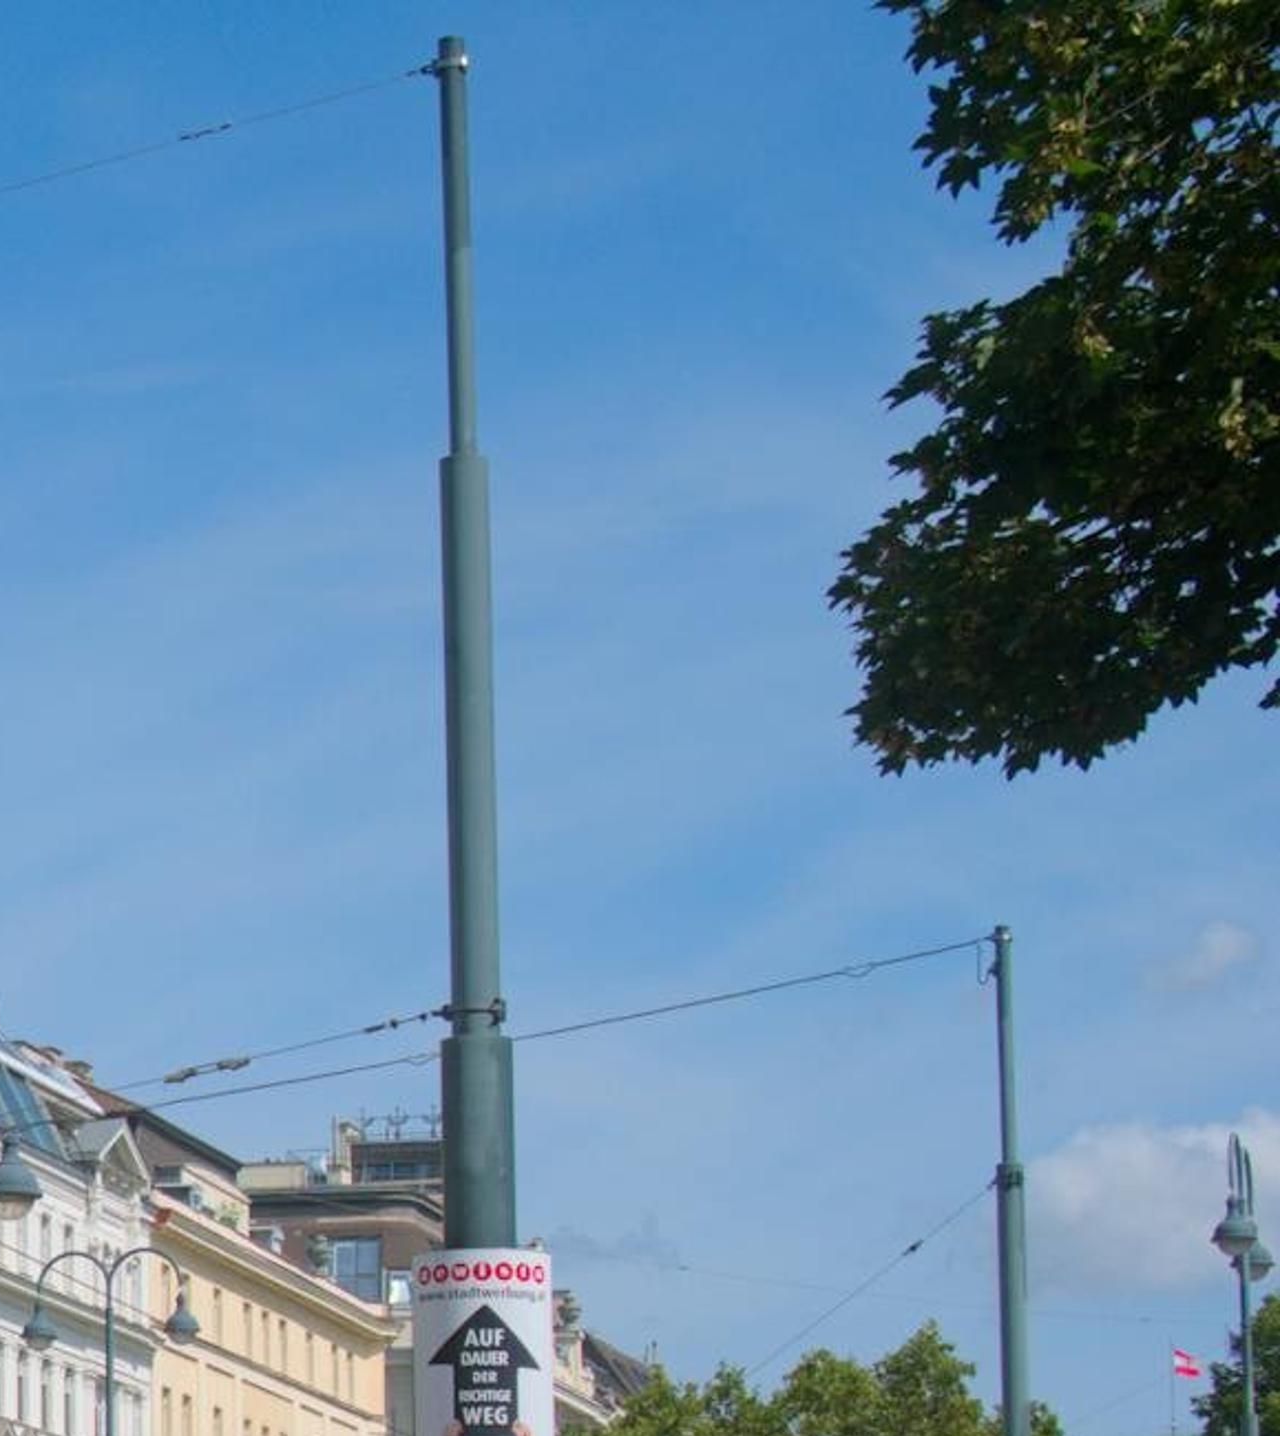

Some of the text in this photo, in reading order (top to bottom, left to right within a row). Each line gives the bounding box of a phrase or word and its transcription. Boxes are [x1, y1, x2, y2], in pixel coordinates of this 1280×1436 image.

[464, 1328, 506, 1347] AUF
[460, 1351, 509, 1367] DAUER
[472, 1371, 498, 1384] DER
[459, 1388, 511, 1403] RICHTIGE
[462, 1405, 508, 1426] WEG
